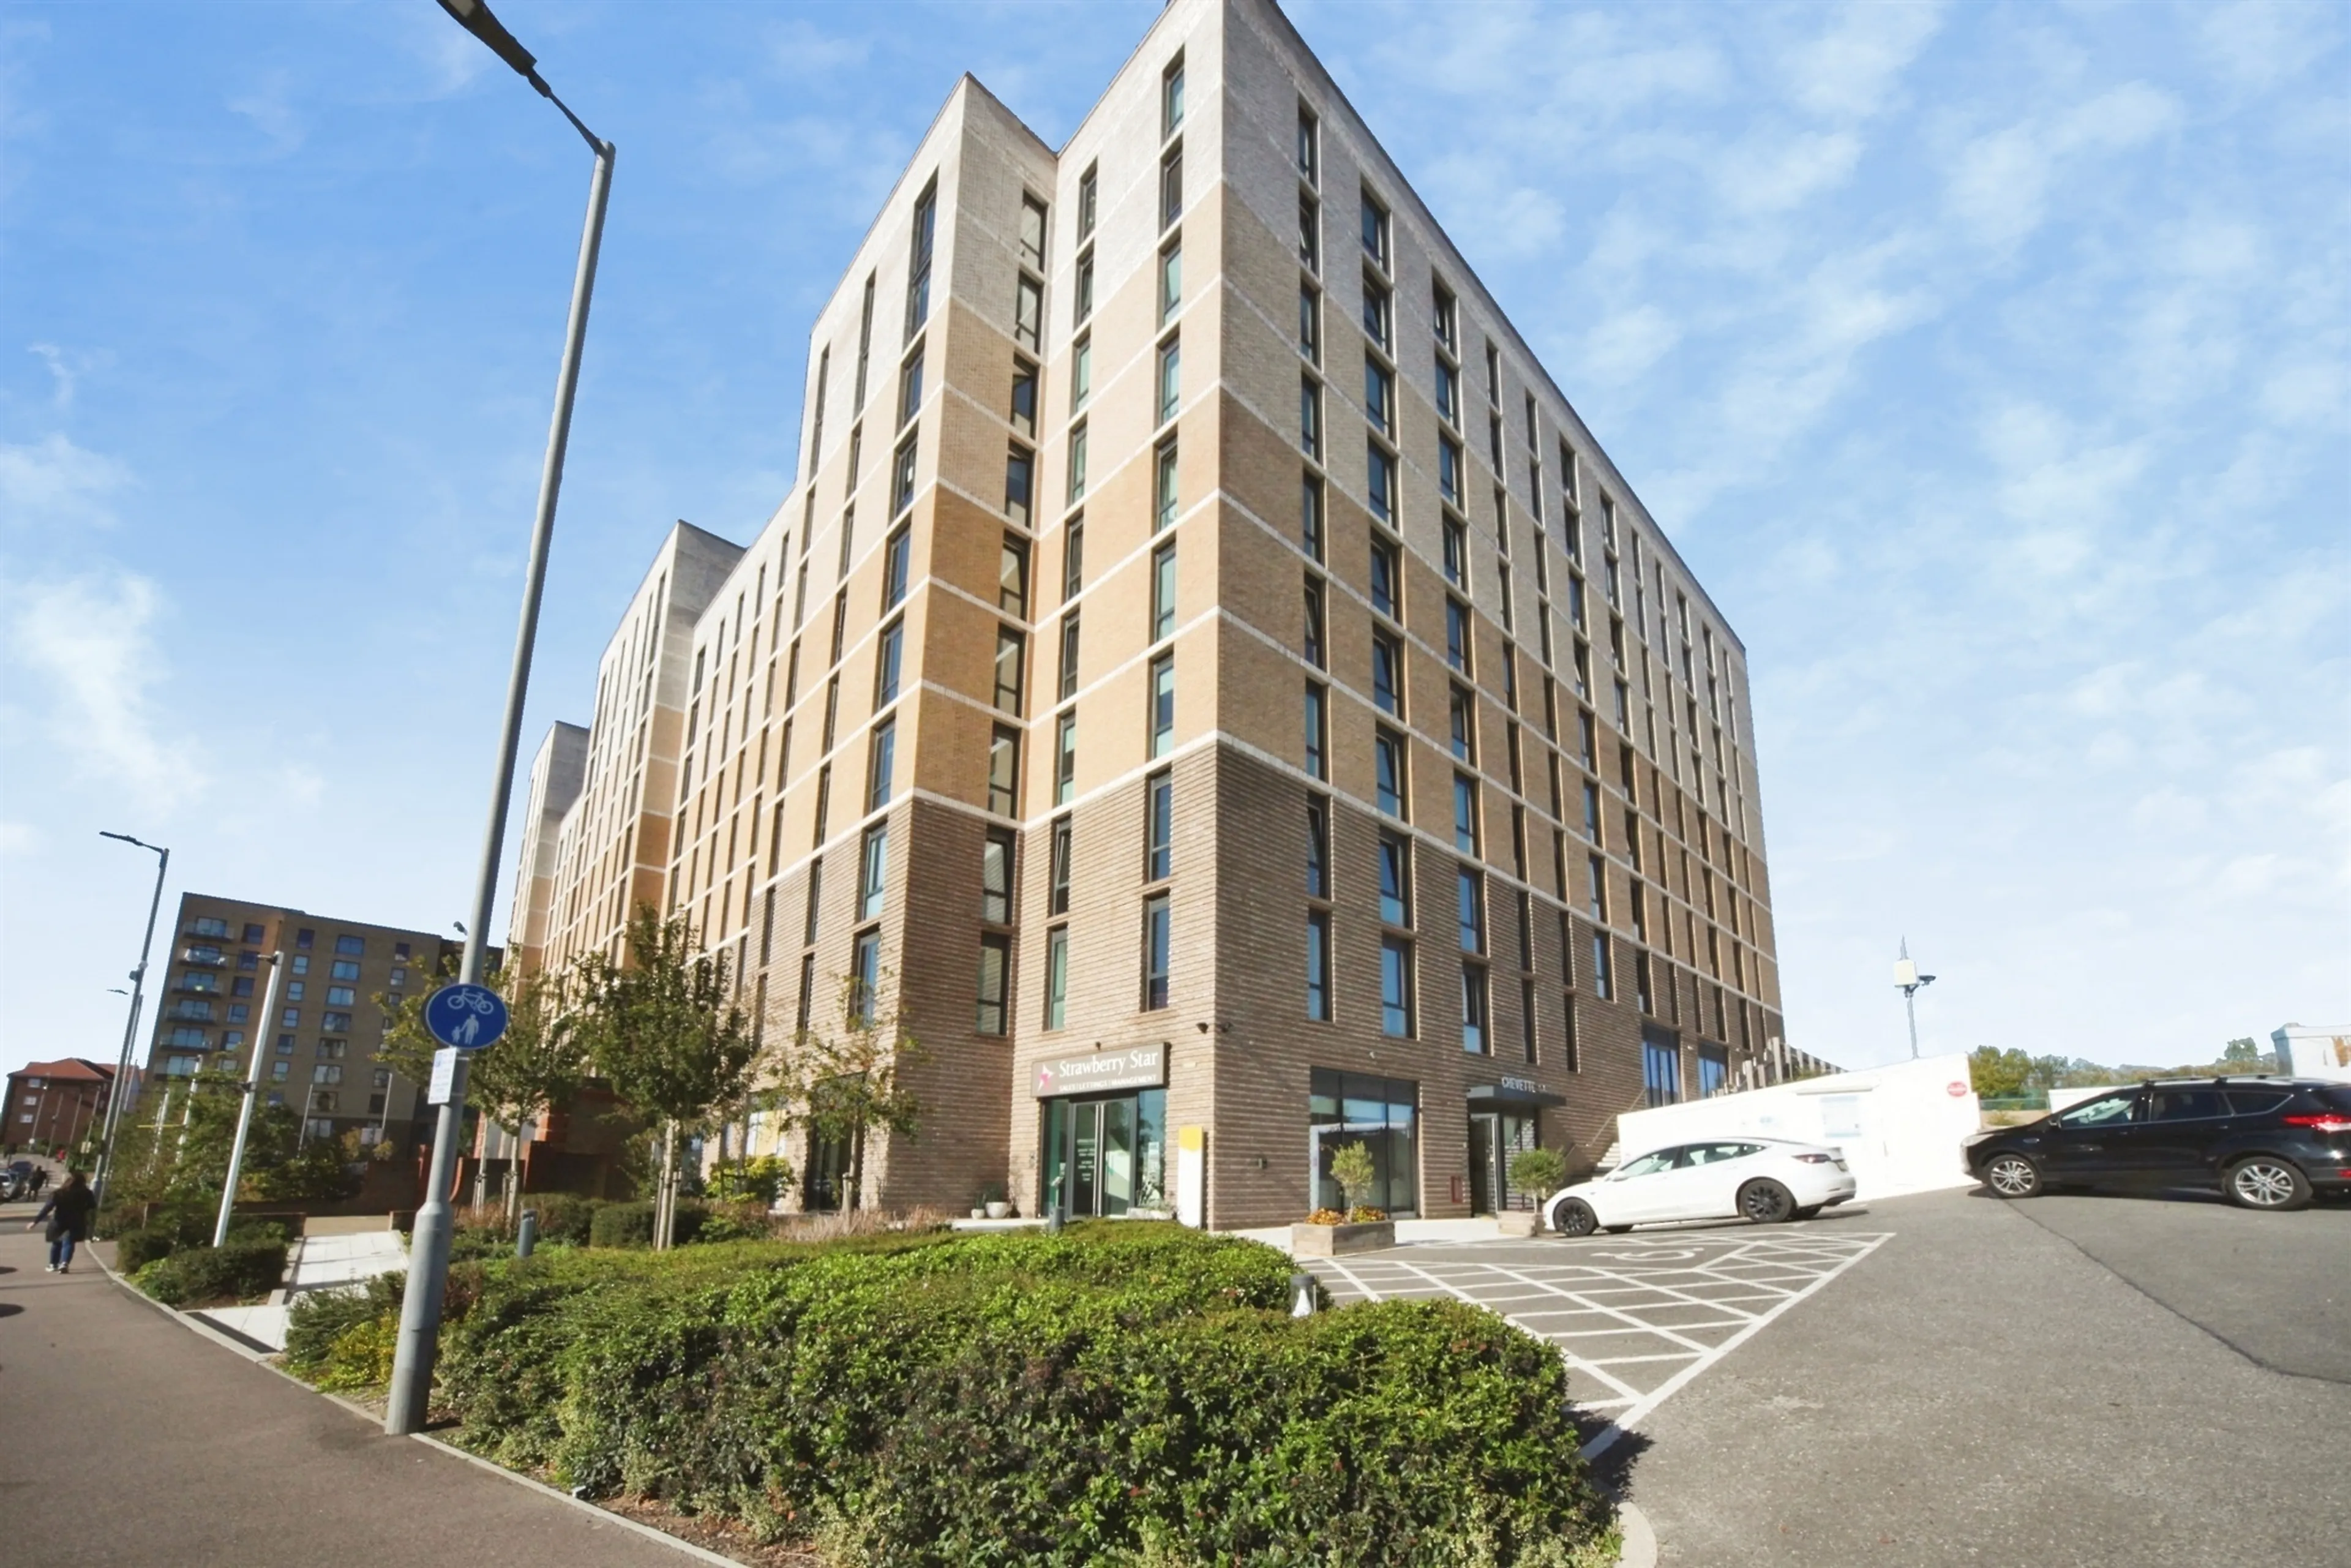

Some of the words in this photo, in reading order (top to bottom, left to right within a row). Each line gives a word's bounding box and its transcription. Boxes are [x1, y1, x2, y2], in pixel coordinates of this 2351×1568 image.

[1059, 1055, 1127, 1078] Strawberry
[1130, 1050, 1158, 1068] Star
[1111, 1075, 1157, 1086] MANAGEMENT
